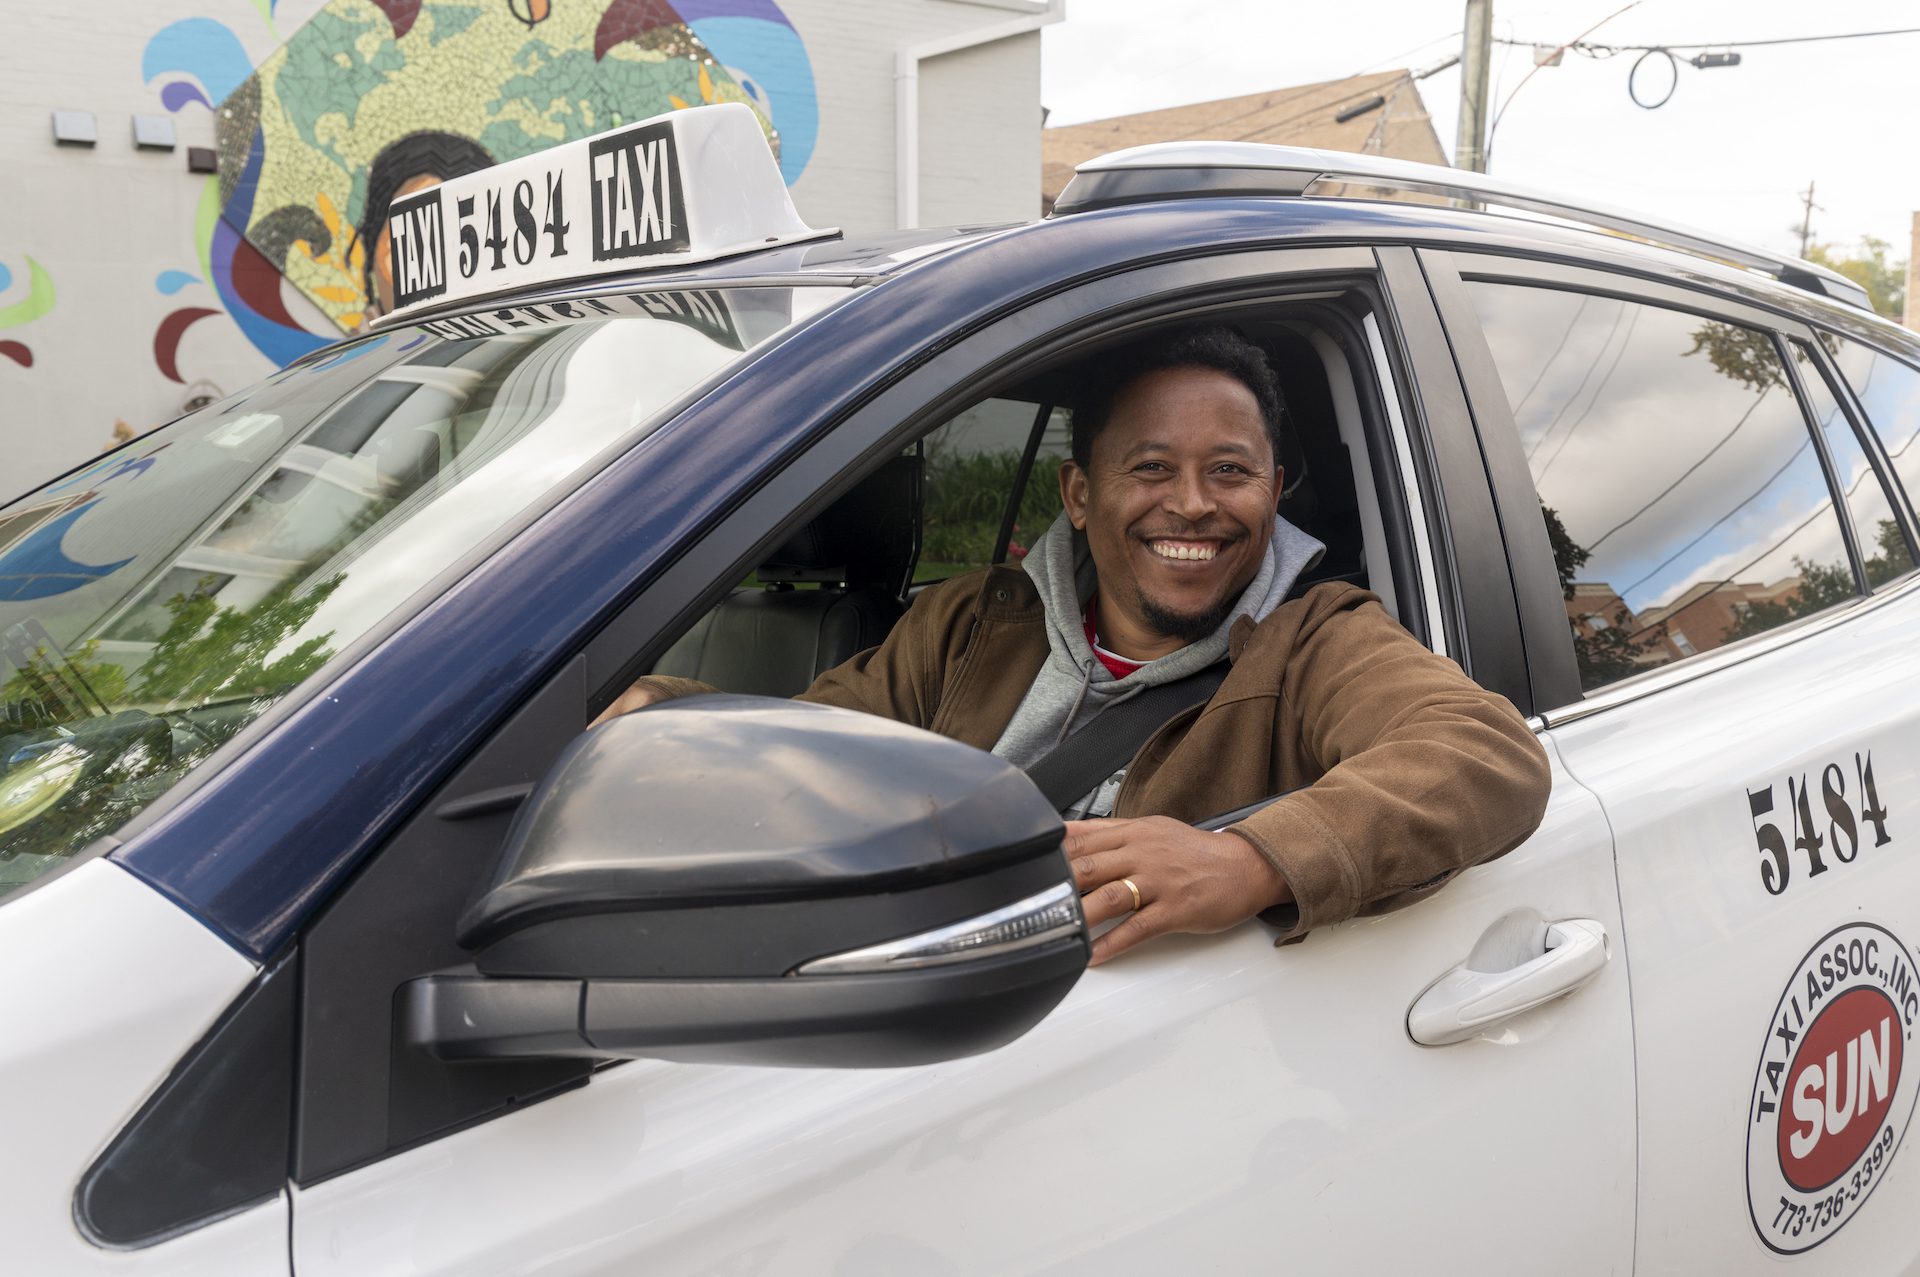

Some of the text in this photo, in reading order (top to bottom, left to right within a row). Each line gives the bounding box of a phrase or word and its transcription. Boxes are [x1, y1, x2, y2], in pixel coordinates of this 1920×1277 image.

[390, 138, 672, 296] TAXI 5484 TAXI
[1746, 749, 1892, 896] 5484
[1757, 996, 1804, 1123] TAXI
[1790, 1016, 1891, 1160] SUN
[1772, 1125, 1894, 1237] 773-736-3399
